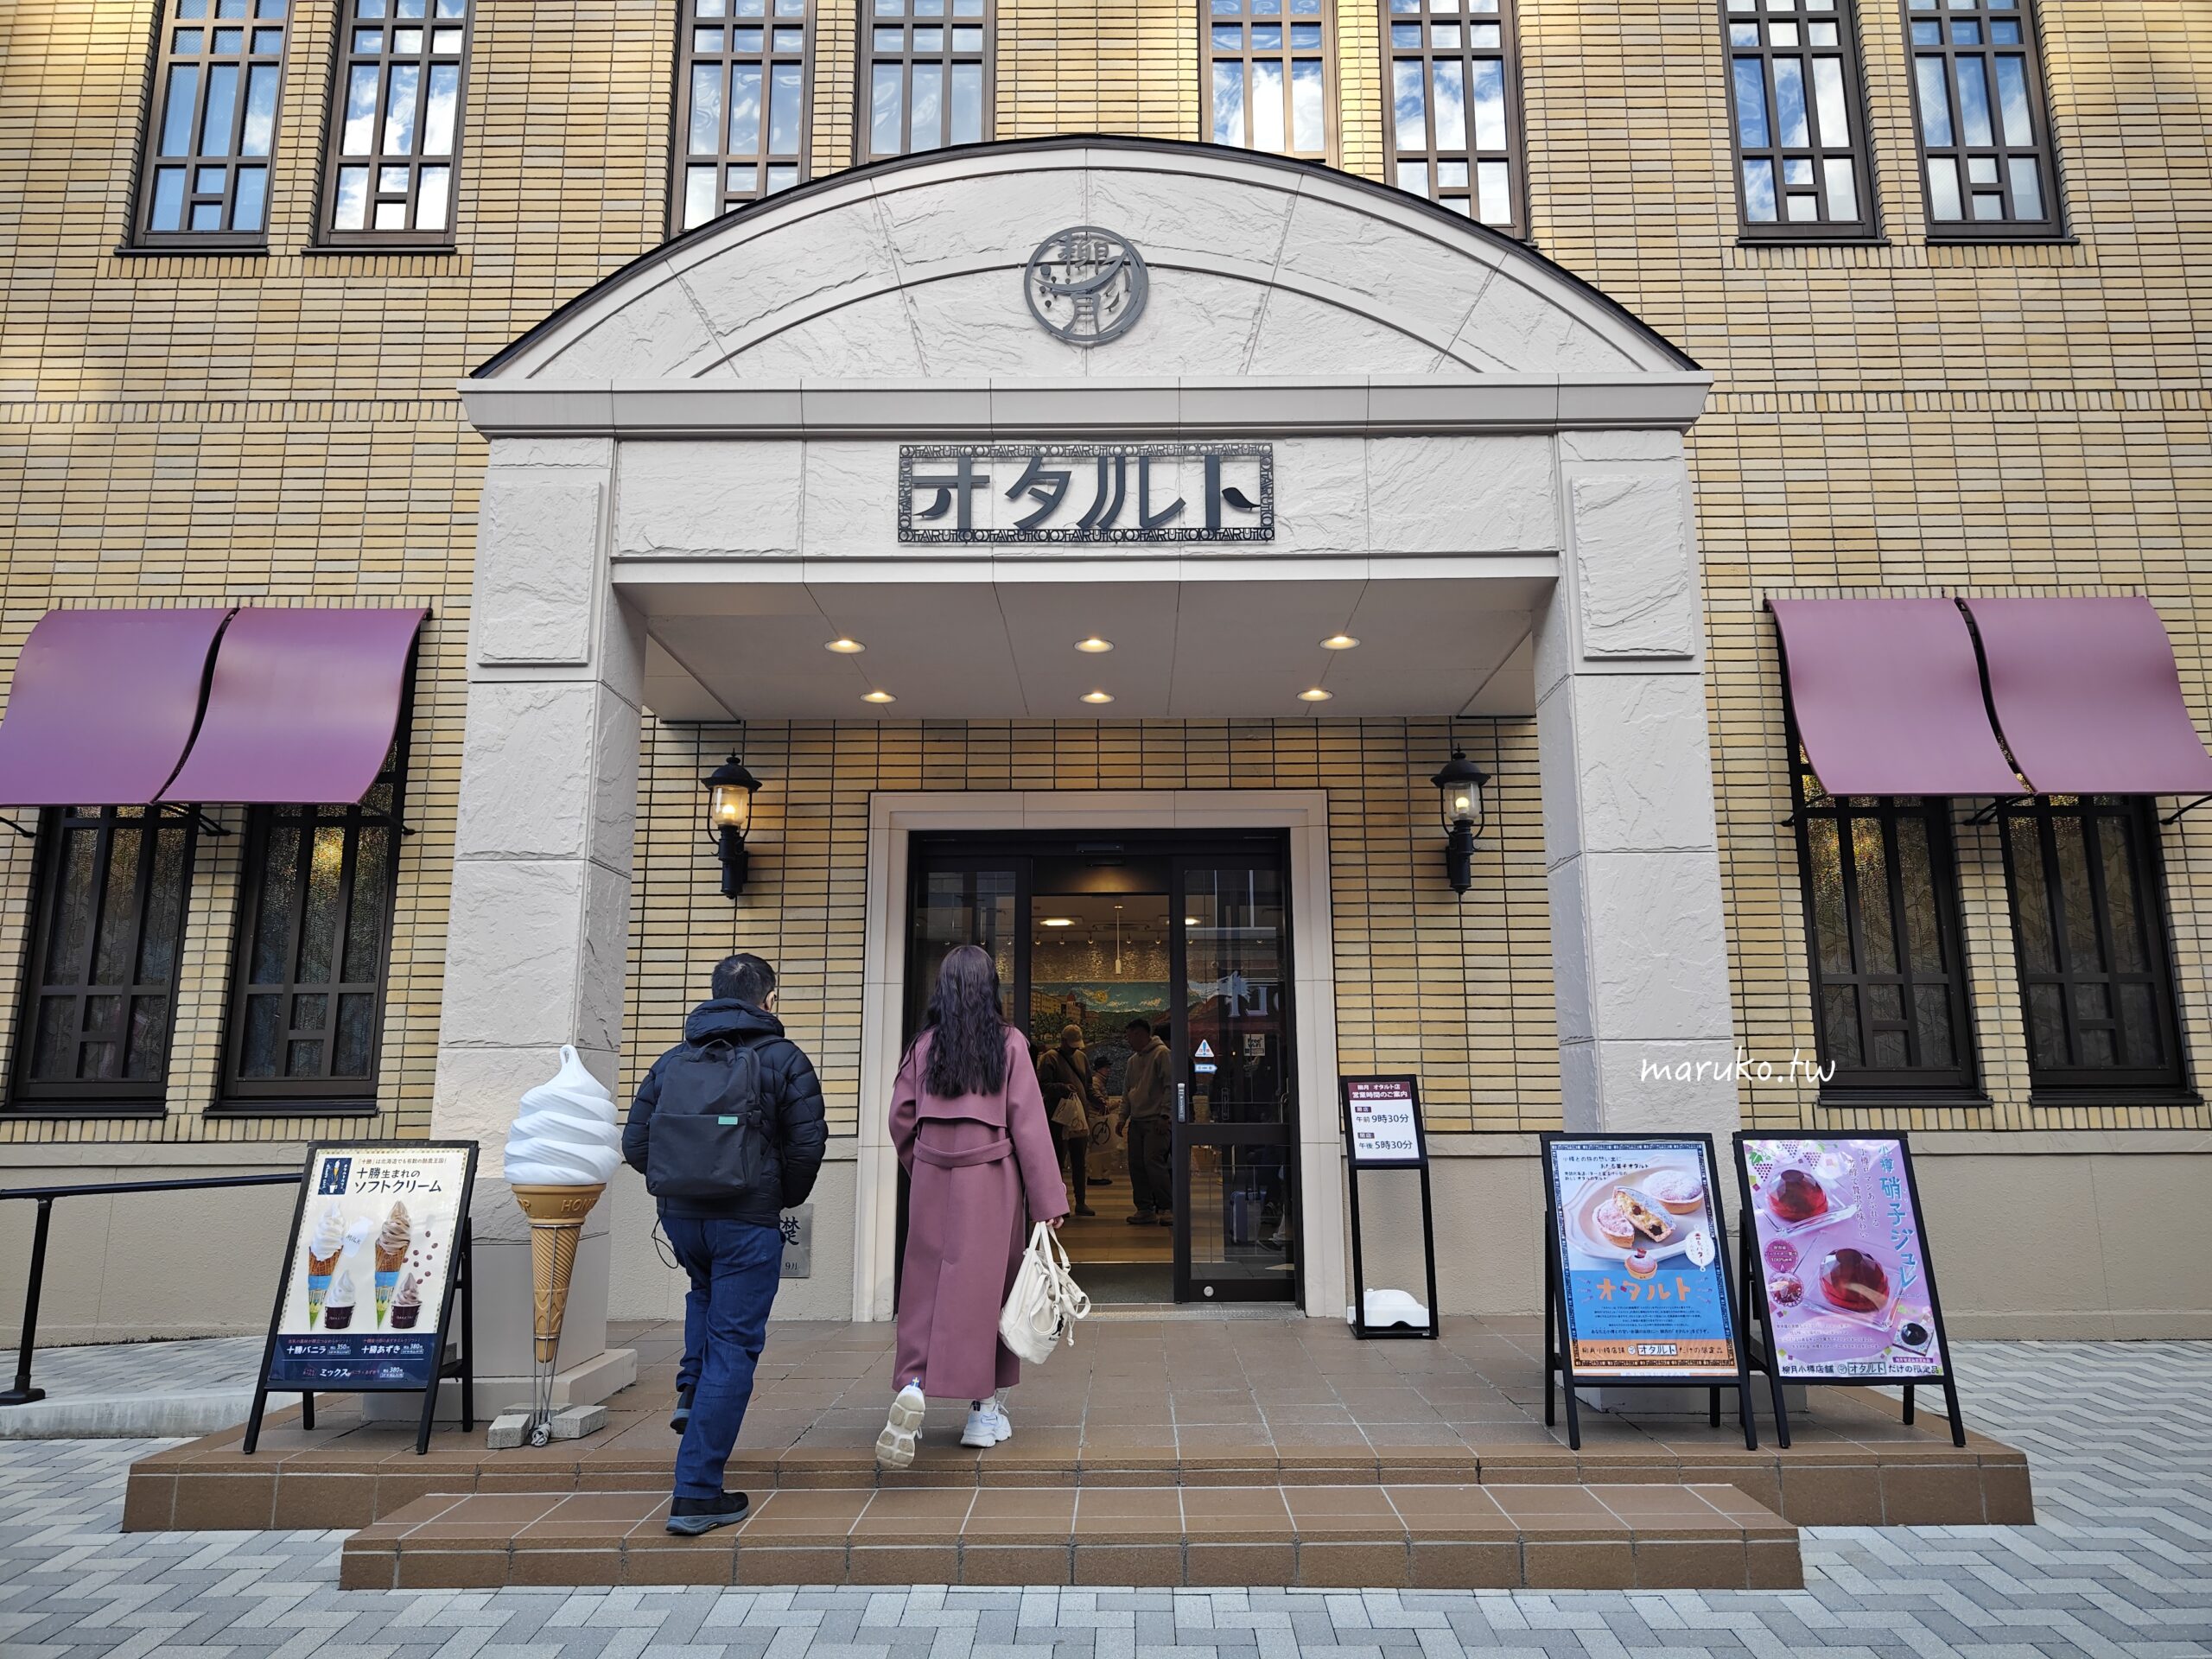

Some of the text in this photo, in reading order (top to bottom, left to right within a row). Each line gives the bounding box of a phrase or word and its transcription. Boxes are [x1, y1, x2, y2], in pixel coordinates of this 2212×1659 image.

[912, 454, 1262, 531] オタルト
[1351, 1090, 1408, 1099] 営業時間のご案内
[1371, 1114, 1409, 1124] 9時30分
[1375, 1140, 1413, 1150] 5時30分
[356, 1167, 421, 1179] 十勝生まれの
[354, 1179, 442, 1193] ソフトクリーム
[346, 1234, 361, 1245] MILK
[1596, 1276, 1691, 1301] オタルト
[286, 1345, 327, 1355] 十勝バニラ
[361, 1344, 401, 1355] 十勝あずき
[1638, 1345, 1675, 1354] オタルト
[320, 1368, 349, 1377] ミックス
[1782, 1363, 1940, 1375] 柳月小樽店舗 オタルト だけの限定品
